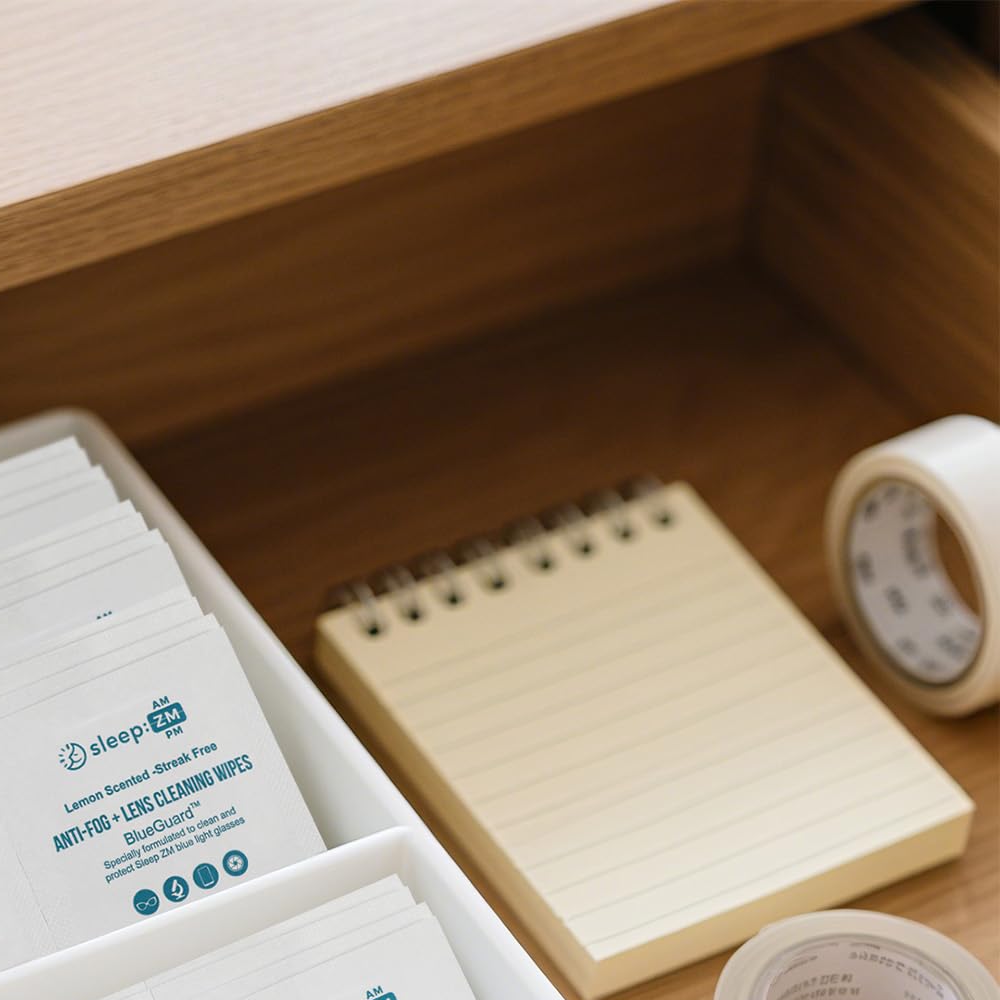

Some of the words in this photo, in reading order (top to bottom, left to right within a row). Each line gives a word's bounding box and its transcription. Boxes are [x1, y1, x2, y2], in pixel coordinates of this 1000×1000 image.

[152, 696, 170, 710] AM
[153, 708, 180, 728] ZM
[165, 725, 184, 740] PM
[64, 791, 104, 814] Lemon
[104, 769, 151, 796] Scented
[191, 743, 217, 759] Free
[53, 814, 112, 853] ANTI-FOG
[120, 796, 155, 823] LENS
[153, 770, 215, 808] CLEANING
[212, 754, 253, 782] WIPES
[104, 849, 141, 870] Specially
[141, 828, 186, 853] formulated
[186, 825, 196, 835] to
[196, 815, 219, 830] clean
[220, 806, 237, 820] and
[105, 864, 135, 884] protect
[135, 854, 160, 869] Sleep
[159, 846, 176, 859] ZM
[175, 839, 194, 852] blue
[194, 830, 214, 844] light
[213, 817, 245, 837] glasses
[366, 985, 384, 1000] AM
